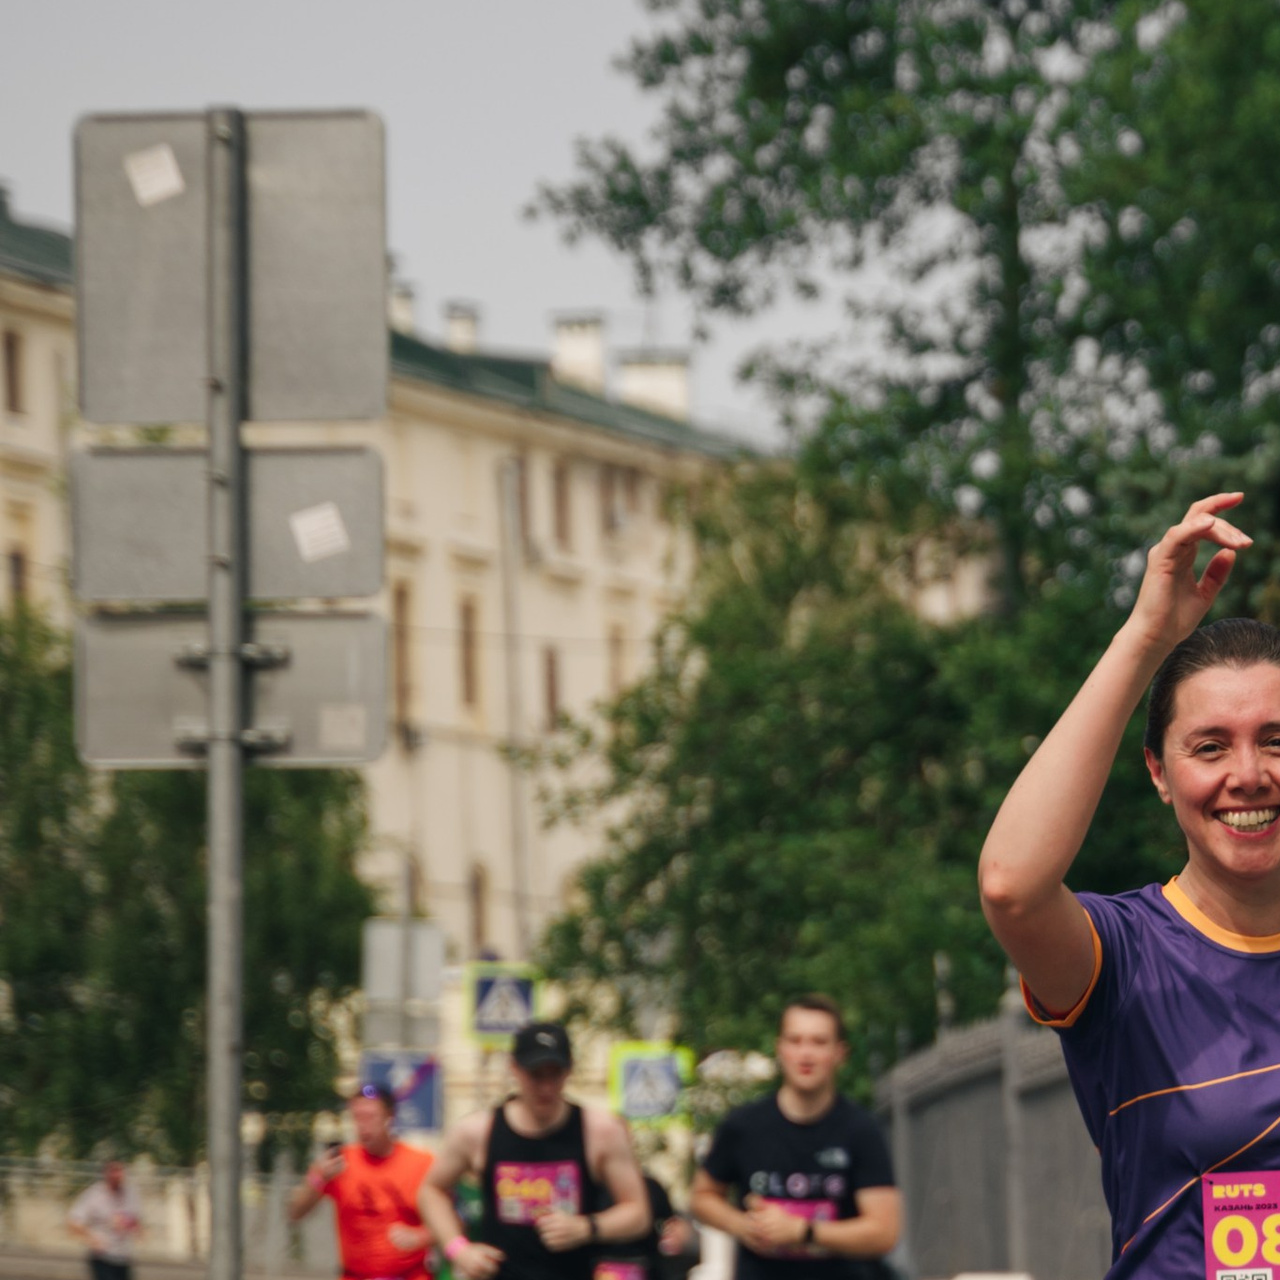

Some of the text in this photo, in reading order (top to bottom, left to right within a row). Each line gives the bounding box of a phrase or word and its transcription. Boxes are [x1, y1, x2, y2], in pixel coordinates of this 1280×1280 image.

[1212, 1183, 1266, 1199] RUTS
[1214, 1202, 1278, 1212] КАЗАНЬ 2023
